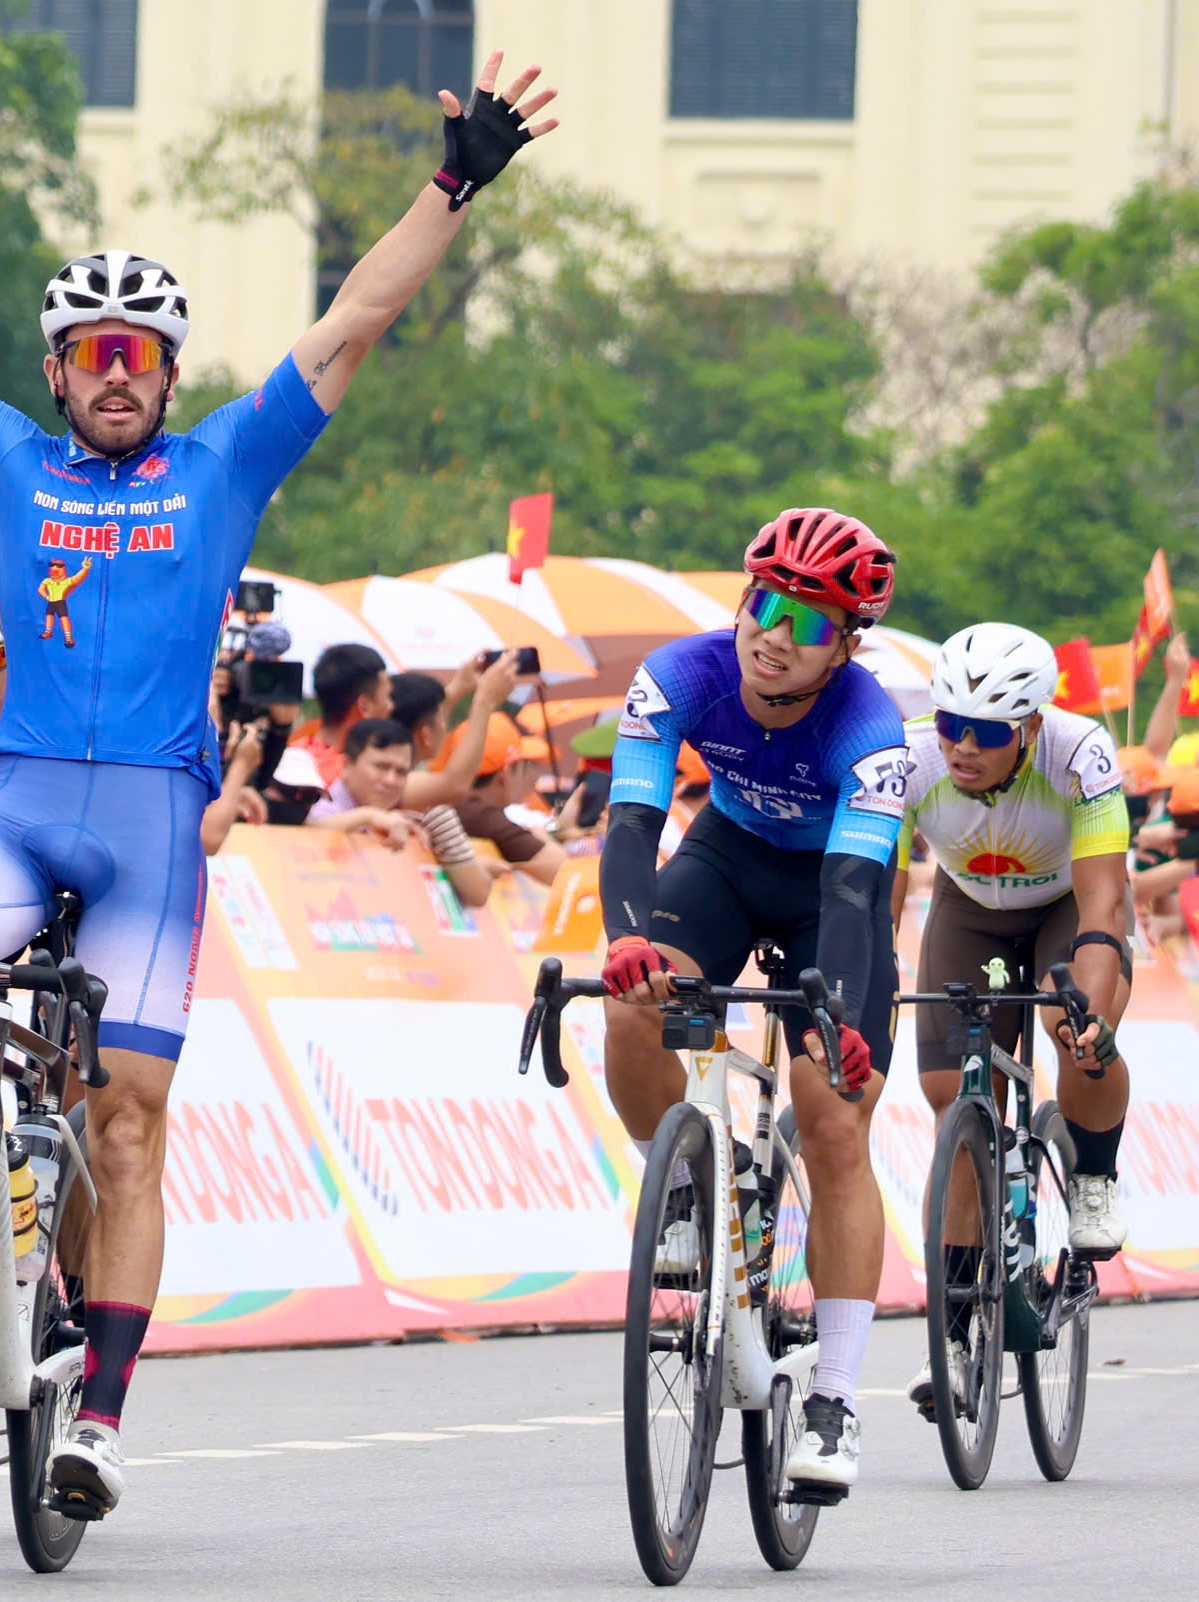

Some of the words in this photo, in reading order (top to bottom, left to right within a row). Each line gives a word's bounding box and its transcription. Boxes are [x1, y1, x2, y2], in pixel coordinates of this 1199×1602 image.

[33, 490, 59, 511] NON
[130, 499, 159, 516] MỘT
[39, 520, 119, 559] NGHỆ
[127, 523, 174, 552] AN
[701, 741, 747, 755] GIANT
[1089, 744, 1111, 774] 3
[727, 769, 749, 787] CHI
